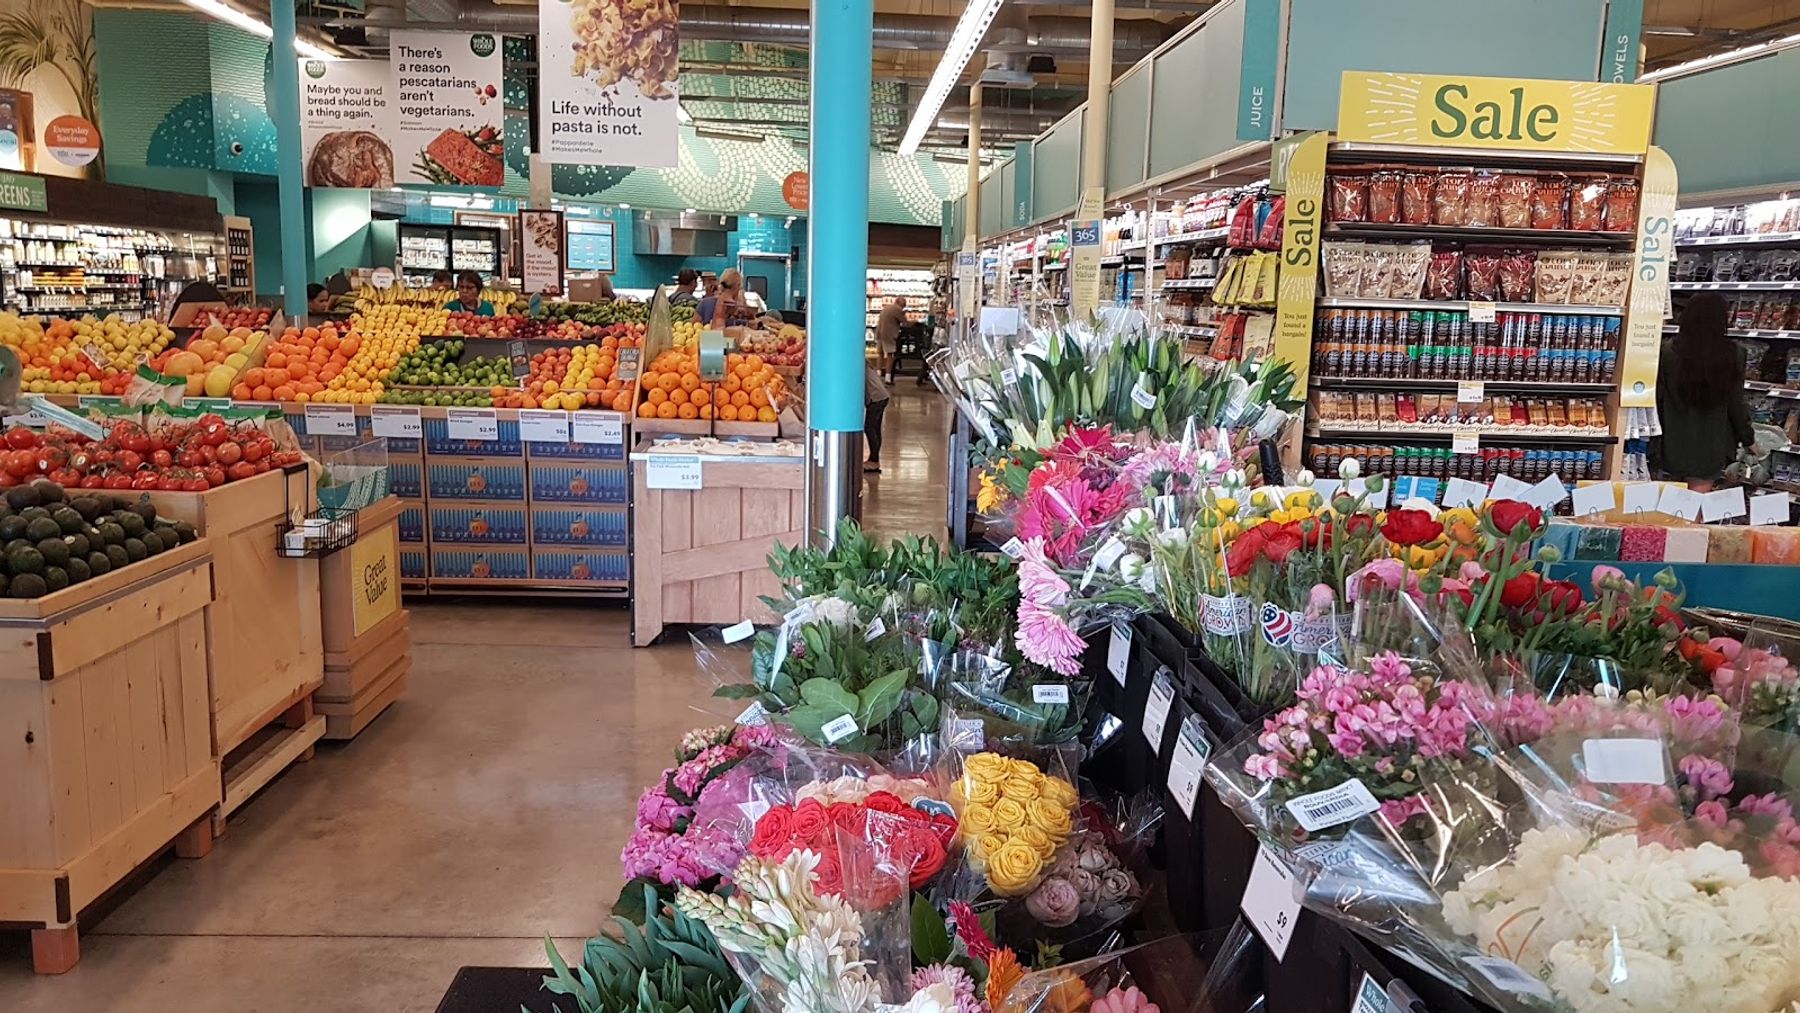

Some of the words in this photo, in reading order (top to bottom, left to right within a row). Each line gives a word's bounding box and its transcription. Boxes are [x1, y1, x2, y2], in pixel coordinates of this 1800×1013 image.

[398, 46, 443, 59] There's
[399, 63, 406, 72] a
[409, 64, 451, 73] reason
[399, 76, 477, 88] pescatarians
[307, 84, 341, 96] Maybe
[343, 87, 362, 96] you
[364, 86, 383, 95] and
[399, 90, 434, 101] aren't
[307, 96, 336, 106] bread
[338, 97, 371, 106] should
[373, 97, 386, 107] be
[1250, 86, 1264, 128] JUICE
[308, 109, 314, 117] a
[316, 108, 341, 119] thing
[343, 109, 373, 120] again.
[400, 104, 475, 118] vegetarians.
[552, 100, 580, 115] Life
[583, 102, 642, 118] without
[1431, 84, 1559, 142] Sale
[52, 125, 89, 136] Everyday
[552, 121, 592, 135] pasta
[597, 120, 609, 134] is
[612, 123, 642, 136] not.
[56, 135, 88, 144] Savings
[1075, 229, 1096, 242] 365
[1286, 199, 1316, 267] Sale
[1639, 216, 1669, 282] Sale
[1075, 263, 1097, 271] Great
[1075, 270, 1096, 278] Value
[1284, 312, 1295, 320] You
[1283, 321, 1301, 329] found
[364, 554, 387, 586] Great
[365, 576, 388, 606] Value
[1276, 911, 1288, 928] $9
[1366, 984, 1385, 1012] Whole
